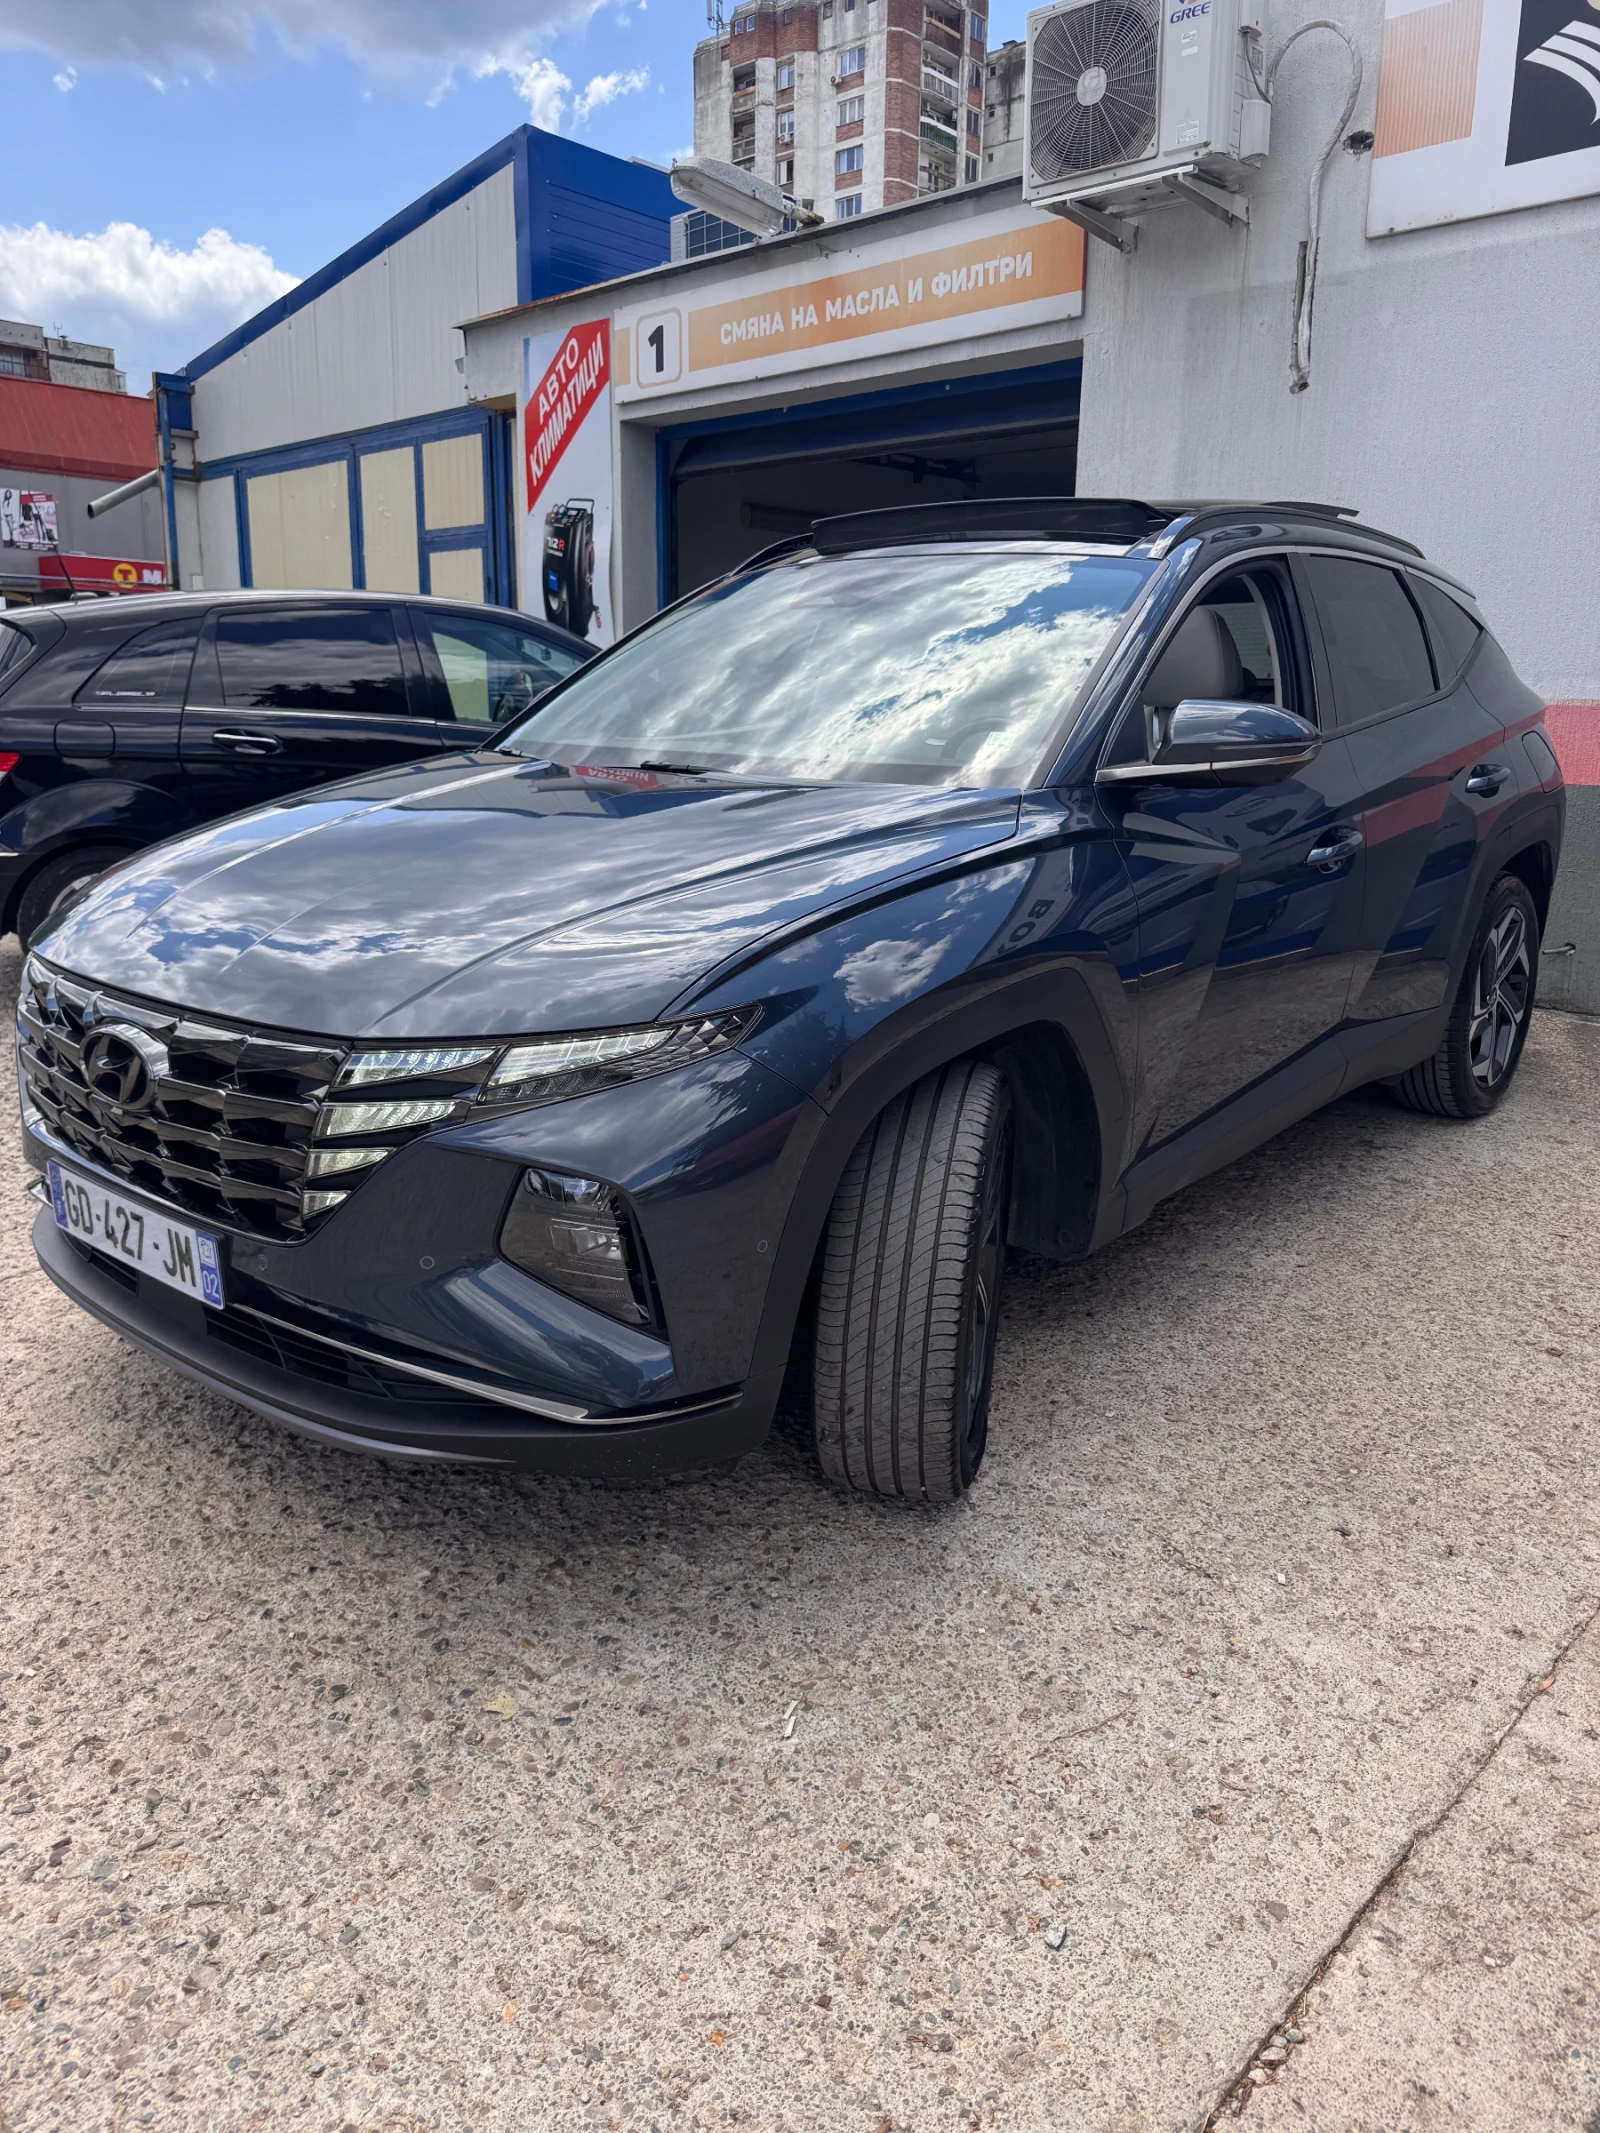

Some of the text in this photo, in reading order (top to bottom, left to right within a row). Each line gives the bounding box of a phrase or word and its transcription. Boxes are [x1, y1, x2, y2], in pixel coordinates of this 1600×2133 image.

[1170, 1, 1211, 24] GREE
[720, 251, 1033, 346] СМЯНА НА МАСЛА И ФИЛТРИ
[538, 337, 579, 425] АВТО
[648, 325, 665, 373] 1
[529, 331, 604, 487] КЛИМАТИЦИ
[202, 1270, 220, 1298] 02
